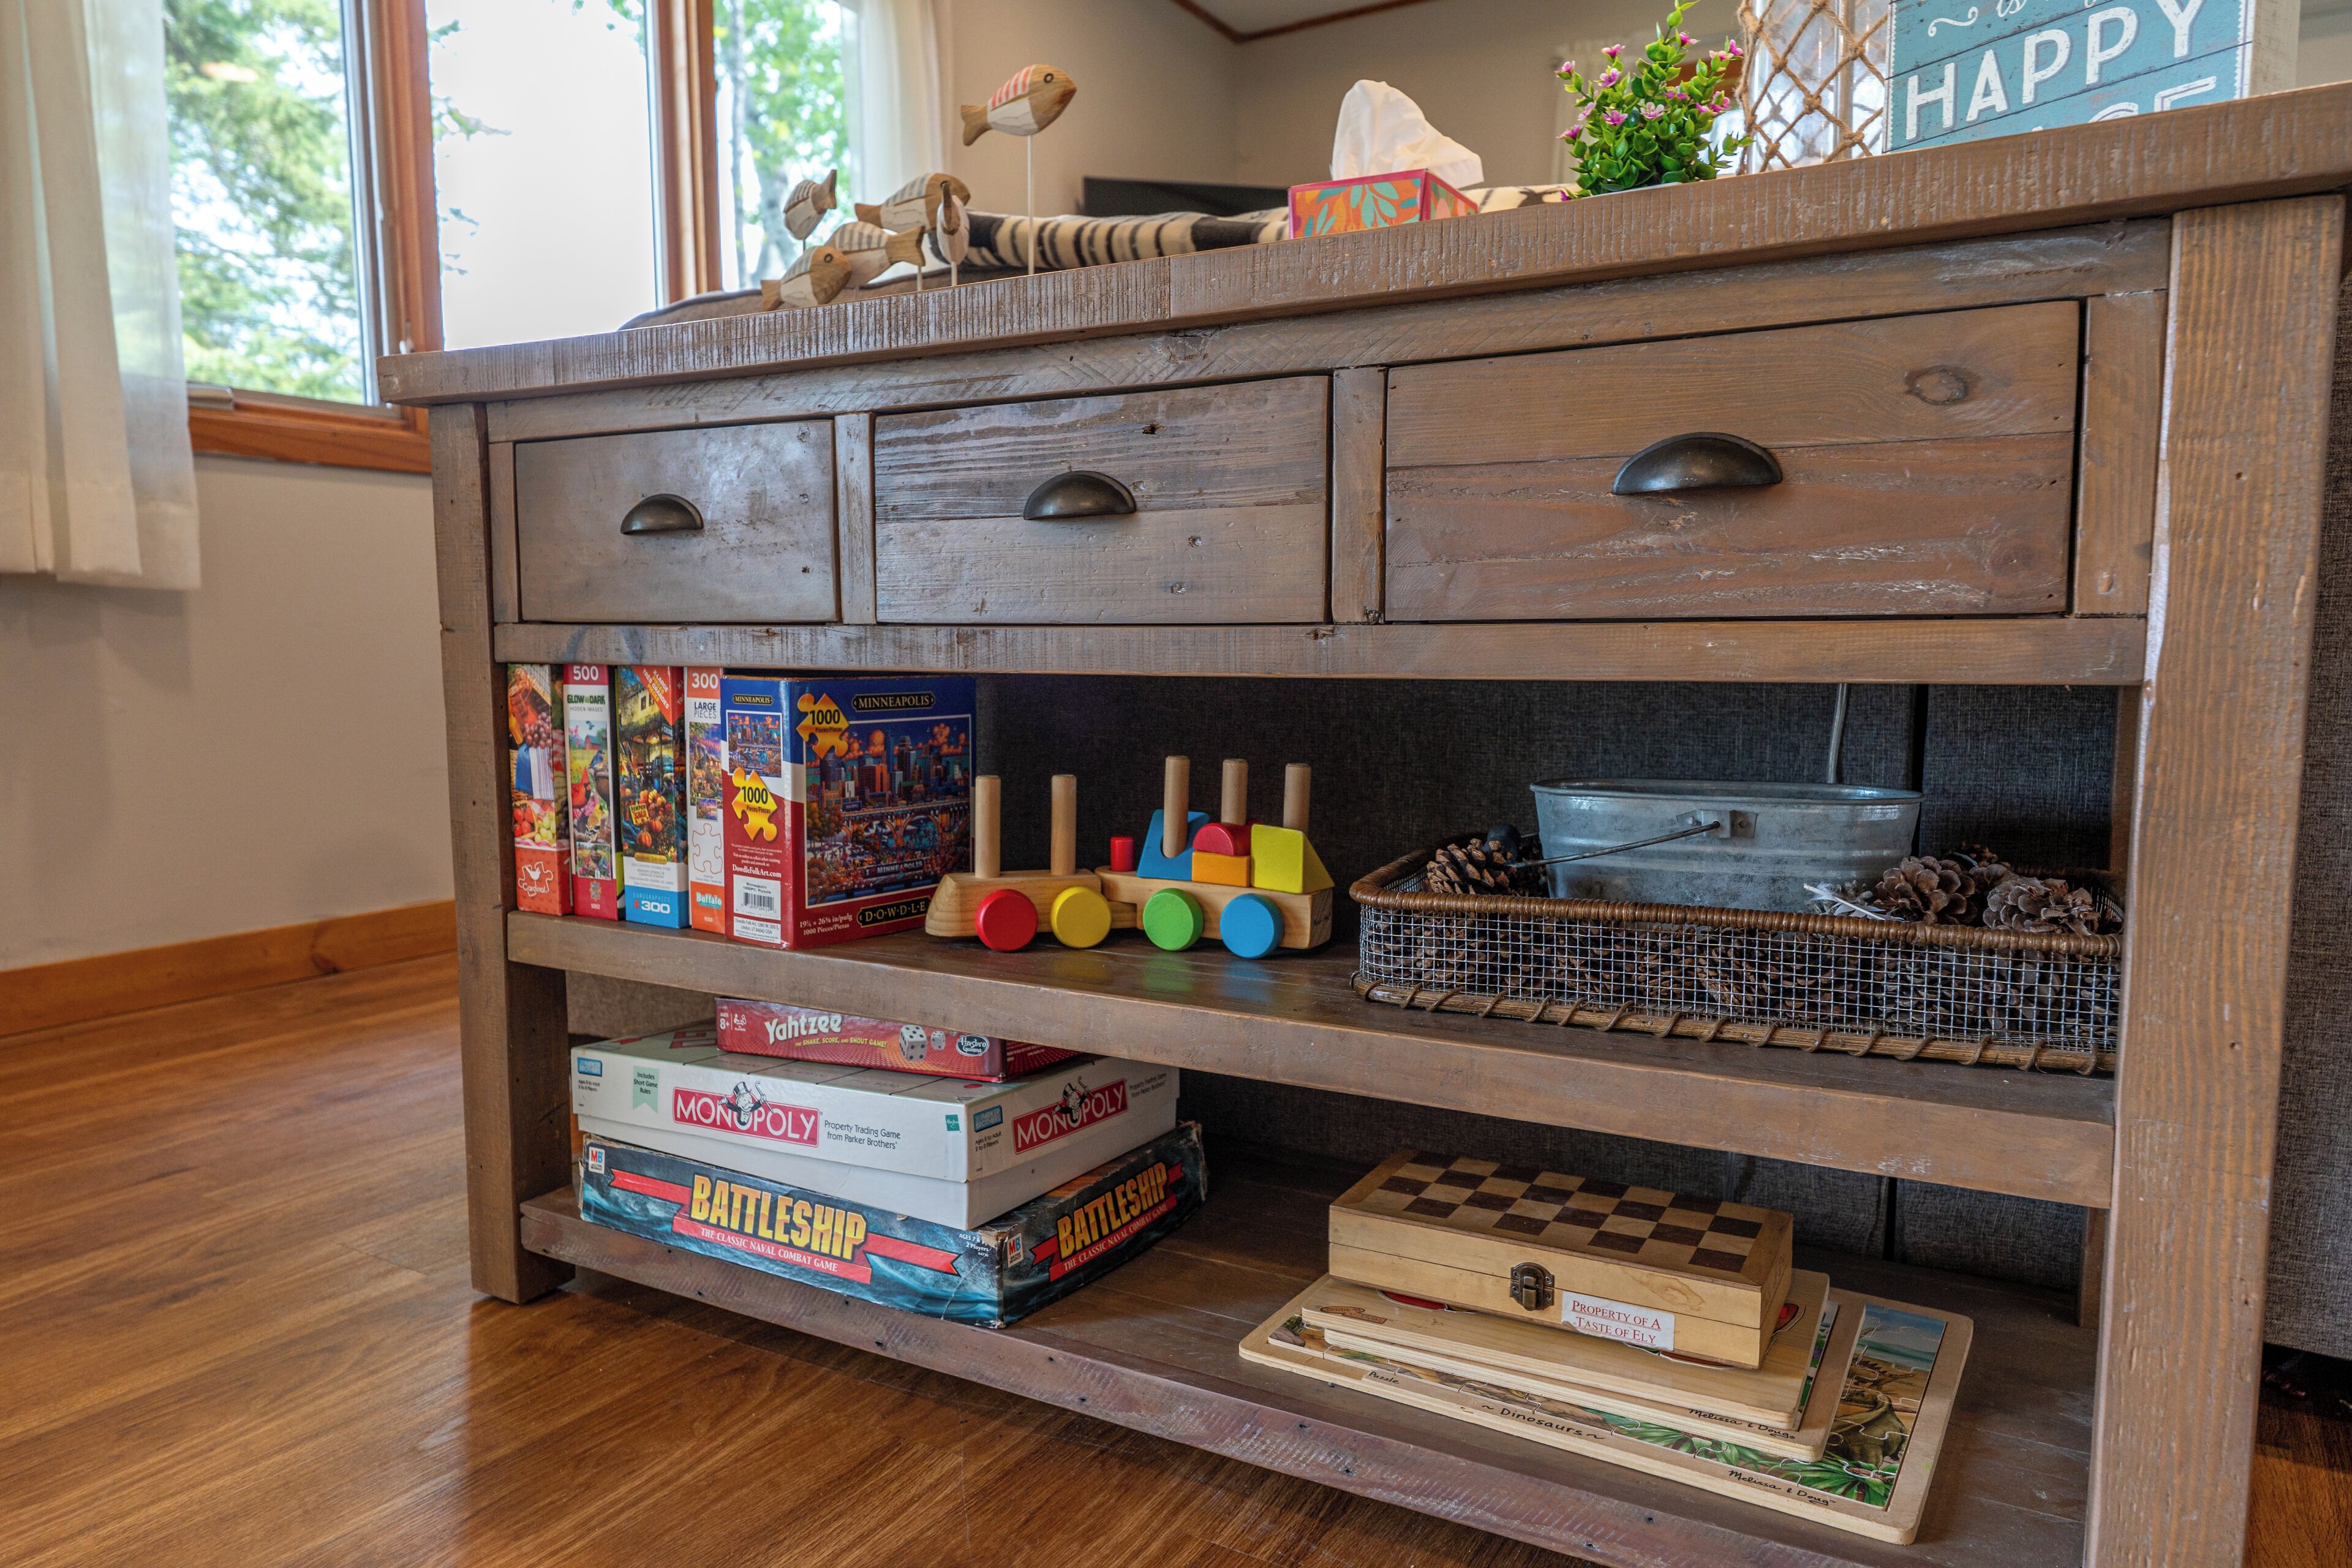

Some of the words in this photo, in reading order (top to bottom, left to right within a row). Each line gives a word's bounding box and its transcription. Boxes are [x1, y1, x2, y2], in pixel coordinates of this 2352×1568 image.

[1905, 0, 2204, 140] HAPPY
[573, 665, 599, 680] 500
[653, 669, 669, 693] X-LARGE
[692, 673, 718, 689] 300
[567, 695, 584, 704] GLOW
[590, 695, 605, 704] DARK
[652, 682, 669, 709] GRANDES
[859, 695, 930, 709] MINNEAPOLIS
[694, 702, 716, 710] LARGE
[694, 710, 717, 719] PIECES
[810, 709, 840, 725] 1000
[742, 786, 768, 804] 1000
[746, 805, 771, 814] Pieces/Piezas
[733, 864, 782, 878] DowdleFolkArt.com
[522, 883, 546, 894] Cardinal
[696, 892, 722, 905] Buffalo
[641, 900, 671, 914] 300
[818, 923, 850, 933] Pieces/Piezas
[720, 1018, 729, 1030] 8+
[764, 1013, 842, 1045] Yahtzee
[869, 1039, 888, 1048] GAME!
[958, 1036, 987, 1048] Hasbro
[676, 1093, 816, 1140] MONOPOLY
[1017, 1085, 1123, 1148] MONOPOLY
[824, 1120, 853, 1133] Property
[855, 1125, 878, 1137] Trading
[880, 1129, 901, 1139] Game
[827, 1133, 843, 1141] from
[844, 1134, 865, 1145] Parker
[591, 1149, 603, 1163] MB
[690, 1174, 867, 1261] BATTLESHIP
[1057, 1162, 1167, 1259] BATTLESHIP
[700, 1227, 715, 1238] THE
[717, 1232, 747, 1248] CLASSIC
[749, 1240, 776, 1256] NAVAL
[778, 1248, 812, 1265] COMBAT
[814, 1257, 838, 1272] GAME
[970, 1243, 989, 1252] Players
[1009, 1237, 1020, 1255] MB
[1063, 1259, 1077, 1272] THE
[1078, 1242, 1106, 1262] CLASSIC
[1107, 1229, 1128, 1246] NAVAL
[1128, 1213, 1152, 1233] COMBAT
[1572, 1300, 1630, 1322] PROPERTY
[1634, 1316, 1648, 1325] OF
[1651, 1318, 1661, 1330] A
[1576, 1316, 1611, 1334] TASTE
[1615, 1327, 1629, 1337] OF
[1632, 1329, 1656, 1344] ELY
[1369, 1371, 1400, 1384] Puzzle
[1500, 1408, 1583, 1436] Dinosaurs
[1688, 1408, 1743, 1425] Melissa
[1728, 1469, 1782, 1490] Melissa
